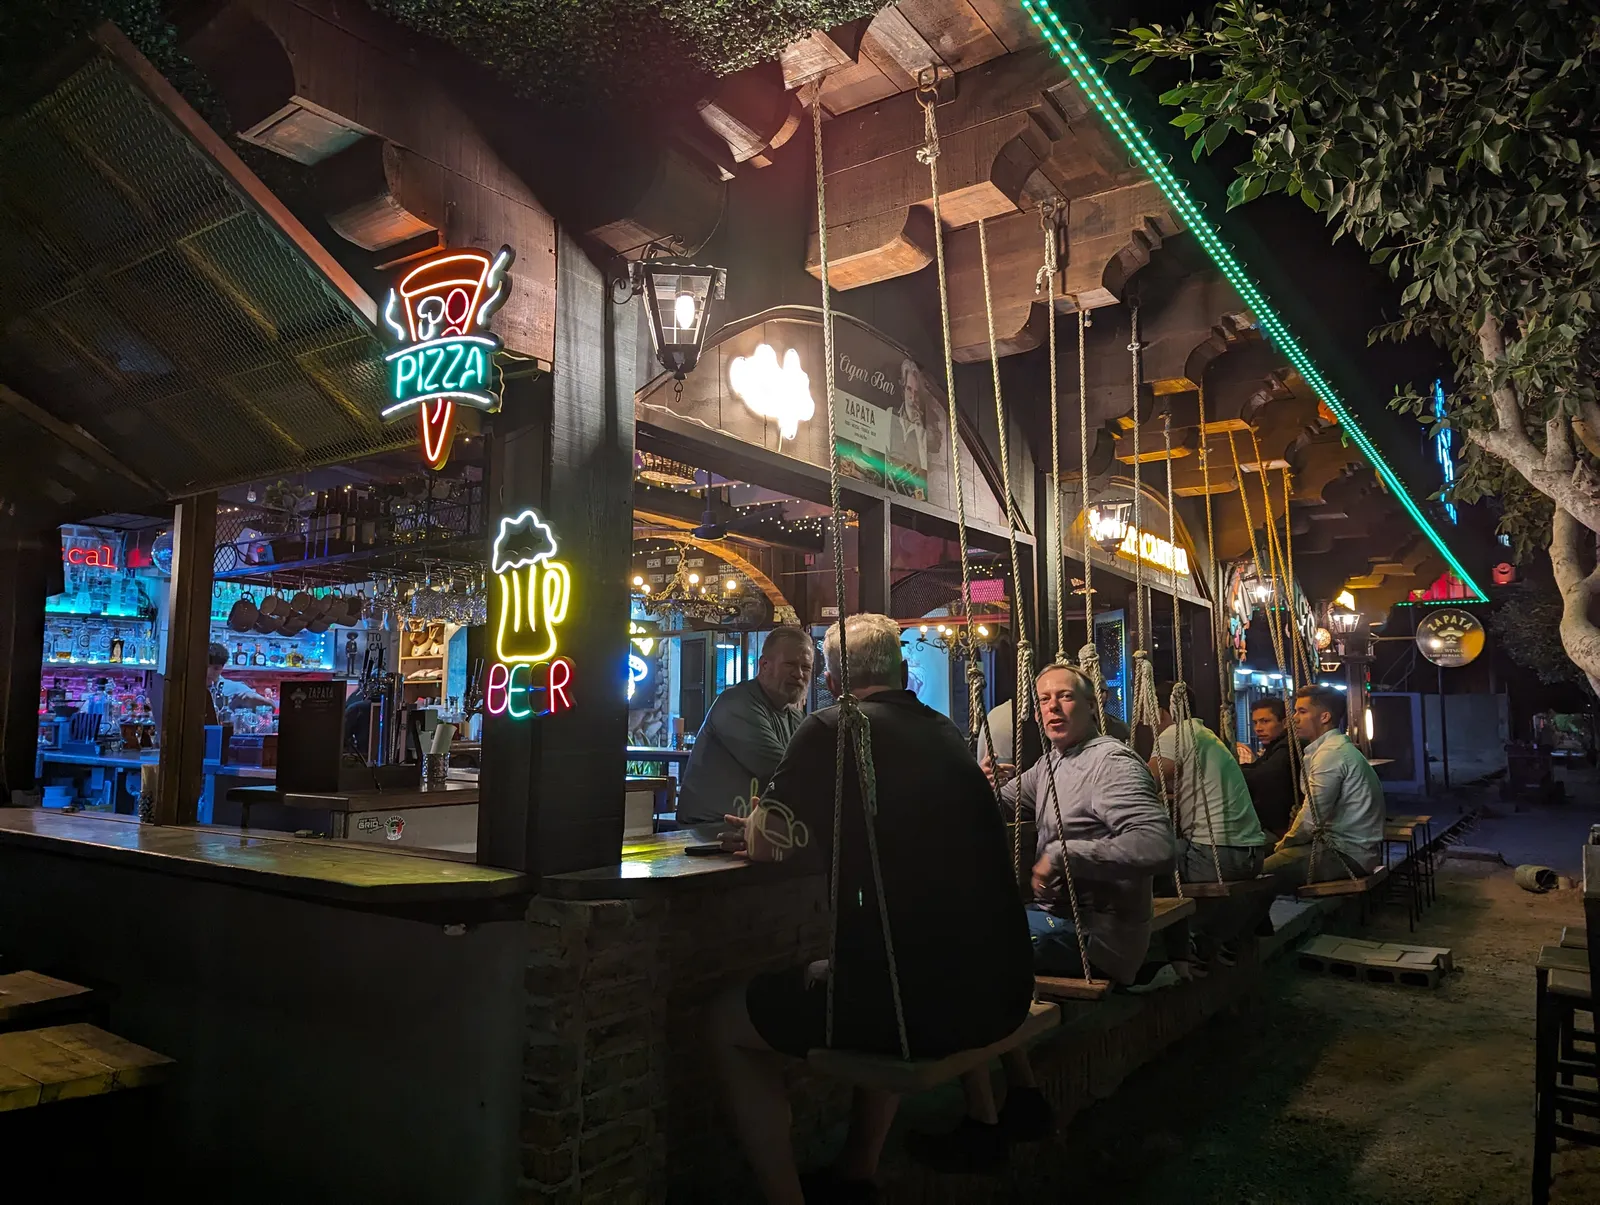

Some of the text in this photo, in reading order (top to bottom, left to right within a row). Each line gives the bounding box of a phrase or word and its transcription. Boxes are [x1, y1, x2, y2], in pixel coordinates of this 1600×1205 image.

[396, 346, 484, 398] PIZZA
[839, 352, 896, 396] Cigar Bar
[845, 398, 876, 426] ZAPATA
[61, 545, 116, 569] cal
[1427, 614, 1473, 632] ZAPATA
[308, 685, 334, 699] ZAPATA
[487, 659, 570, 718] BEER
